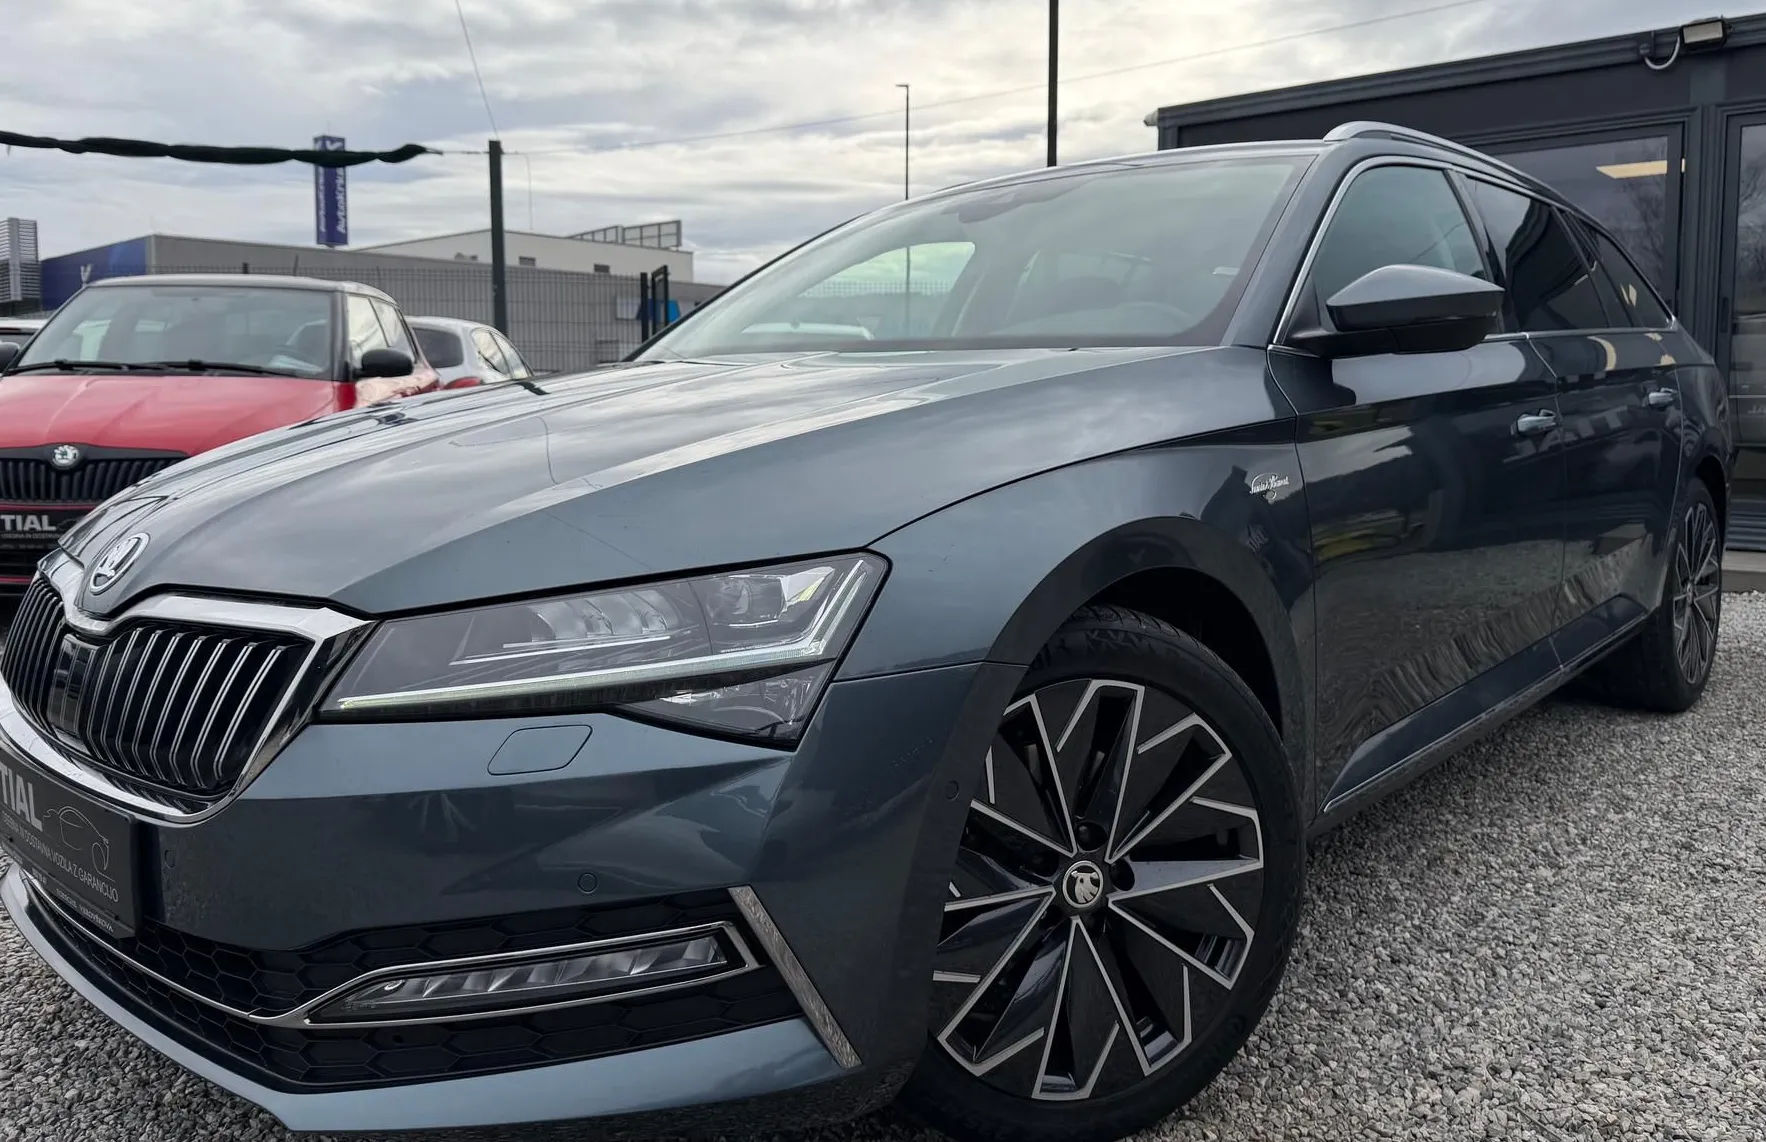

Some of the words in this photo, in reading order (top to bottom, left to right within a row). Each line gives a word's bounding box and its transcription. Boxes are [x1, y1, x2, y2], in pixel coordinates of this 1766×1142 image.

[0, 514, 57, 531] TIAL
[0, 762, 43, 832] TIAL
[72, 863, 78, 878] Z
[78, 867, 119, 902] GARANCIJO
